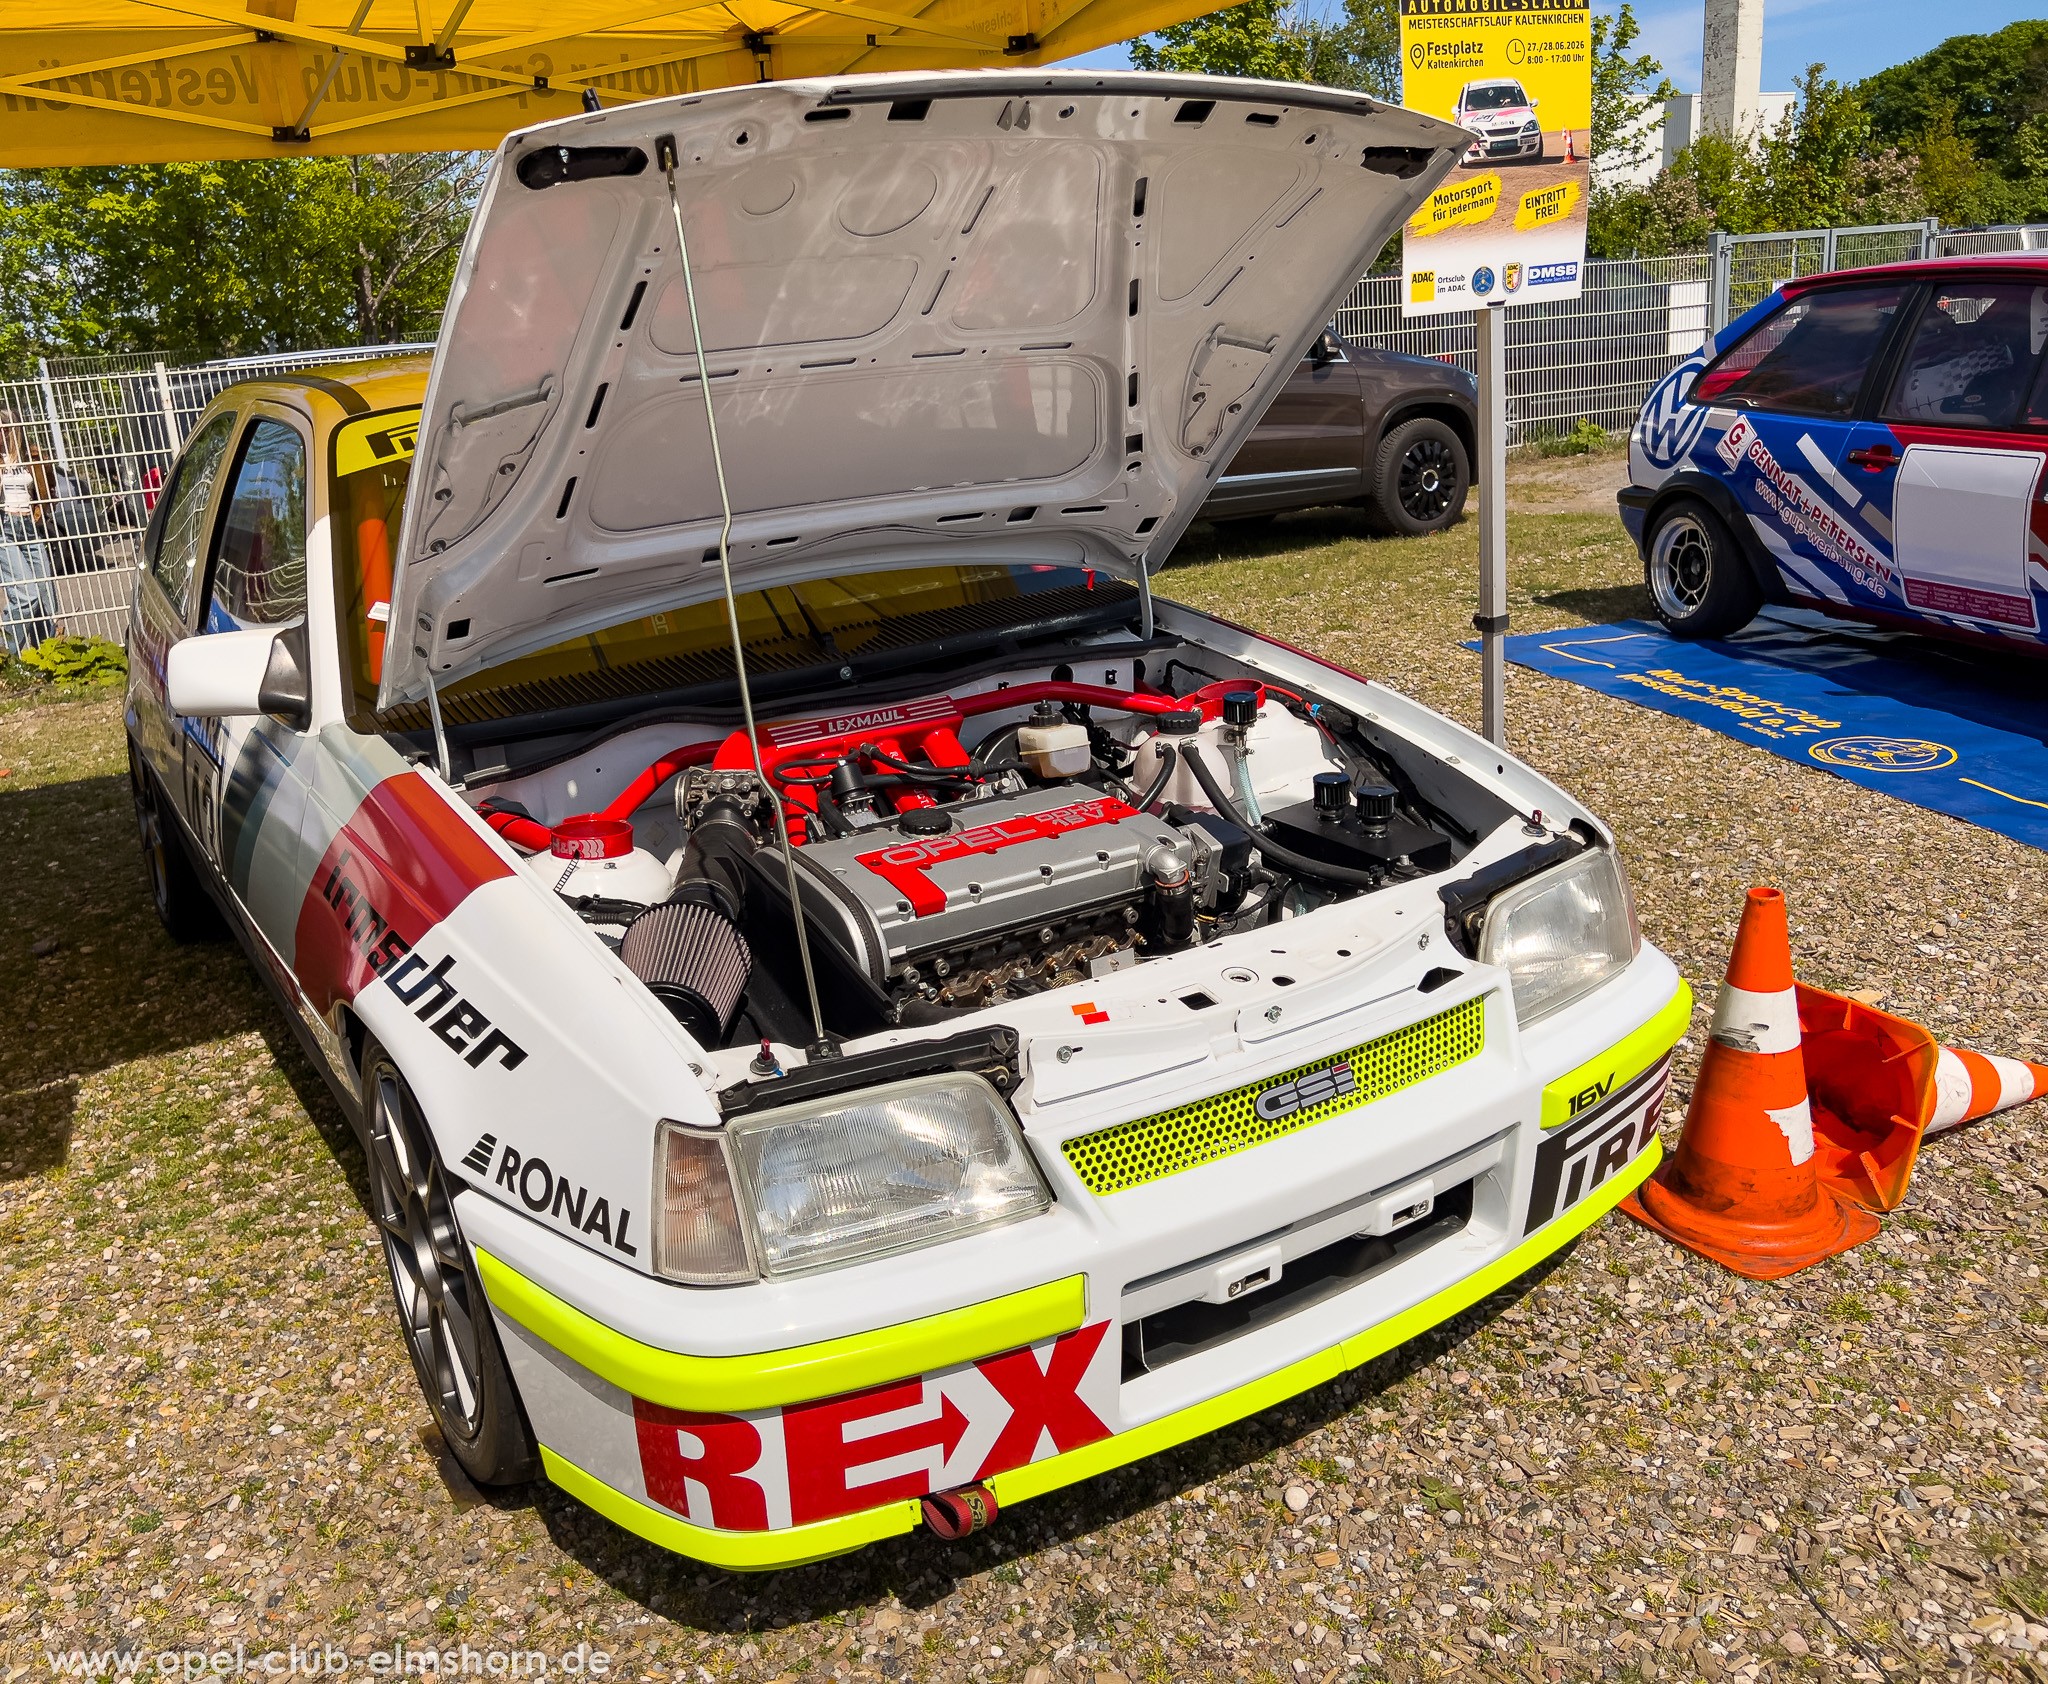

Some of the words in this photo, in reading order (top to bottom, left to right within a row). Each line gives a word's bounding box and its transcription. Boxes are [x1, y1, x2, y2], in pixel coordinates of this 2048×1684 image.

[1408, 16, 1513, 30] MEISTERSCHAFTSLAUF
[1515, 13, 1584, 26] KALTENKIRCHEN
[1427, 40, 1484, 58] Festplatz
[1527, 40, 1585, 53] 27./28.06.2026
[1427, 58, 1484, 69] Kaltenkirchen
[1527, 55, 1544, 65] 8:00
[1551, 54, 1571, 63] 17:00
[1572, 53, 1584, 62] Uhr
[1433, 180, 1493, 208] Motorsport
[1525, 187, 1567, 210] EINTRITT
[1432, 209, 1447, 222] für
[1448, 195, 1495, 219] jedermann
[1535, 203, 1559, 220] FREI!
[1411, 271, 1434, 284] ADAC
[1437, 275, 1466, 284] Ortsclub
[1529, 264, 1577, 280] DMSB
[1437, 286, 1446, 294] im
[1447, 284, 1466, 293] ADAC
[1755, 477, 1887, 599] www.gup-werbung.de
[828, 709, 905, 733] LEXMAUL
[881, 827, 1037, 866] OPEL
[321, 849, 530, 1072] irmscher
[1567, 1071, 1616, 1117] 16V
[495, 1144, 638, 1259] RONAL
[632, 1318, 1114, 1532] REX
